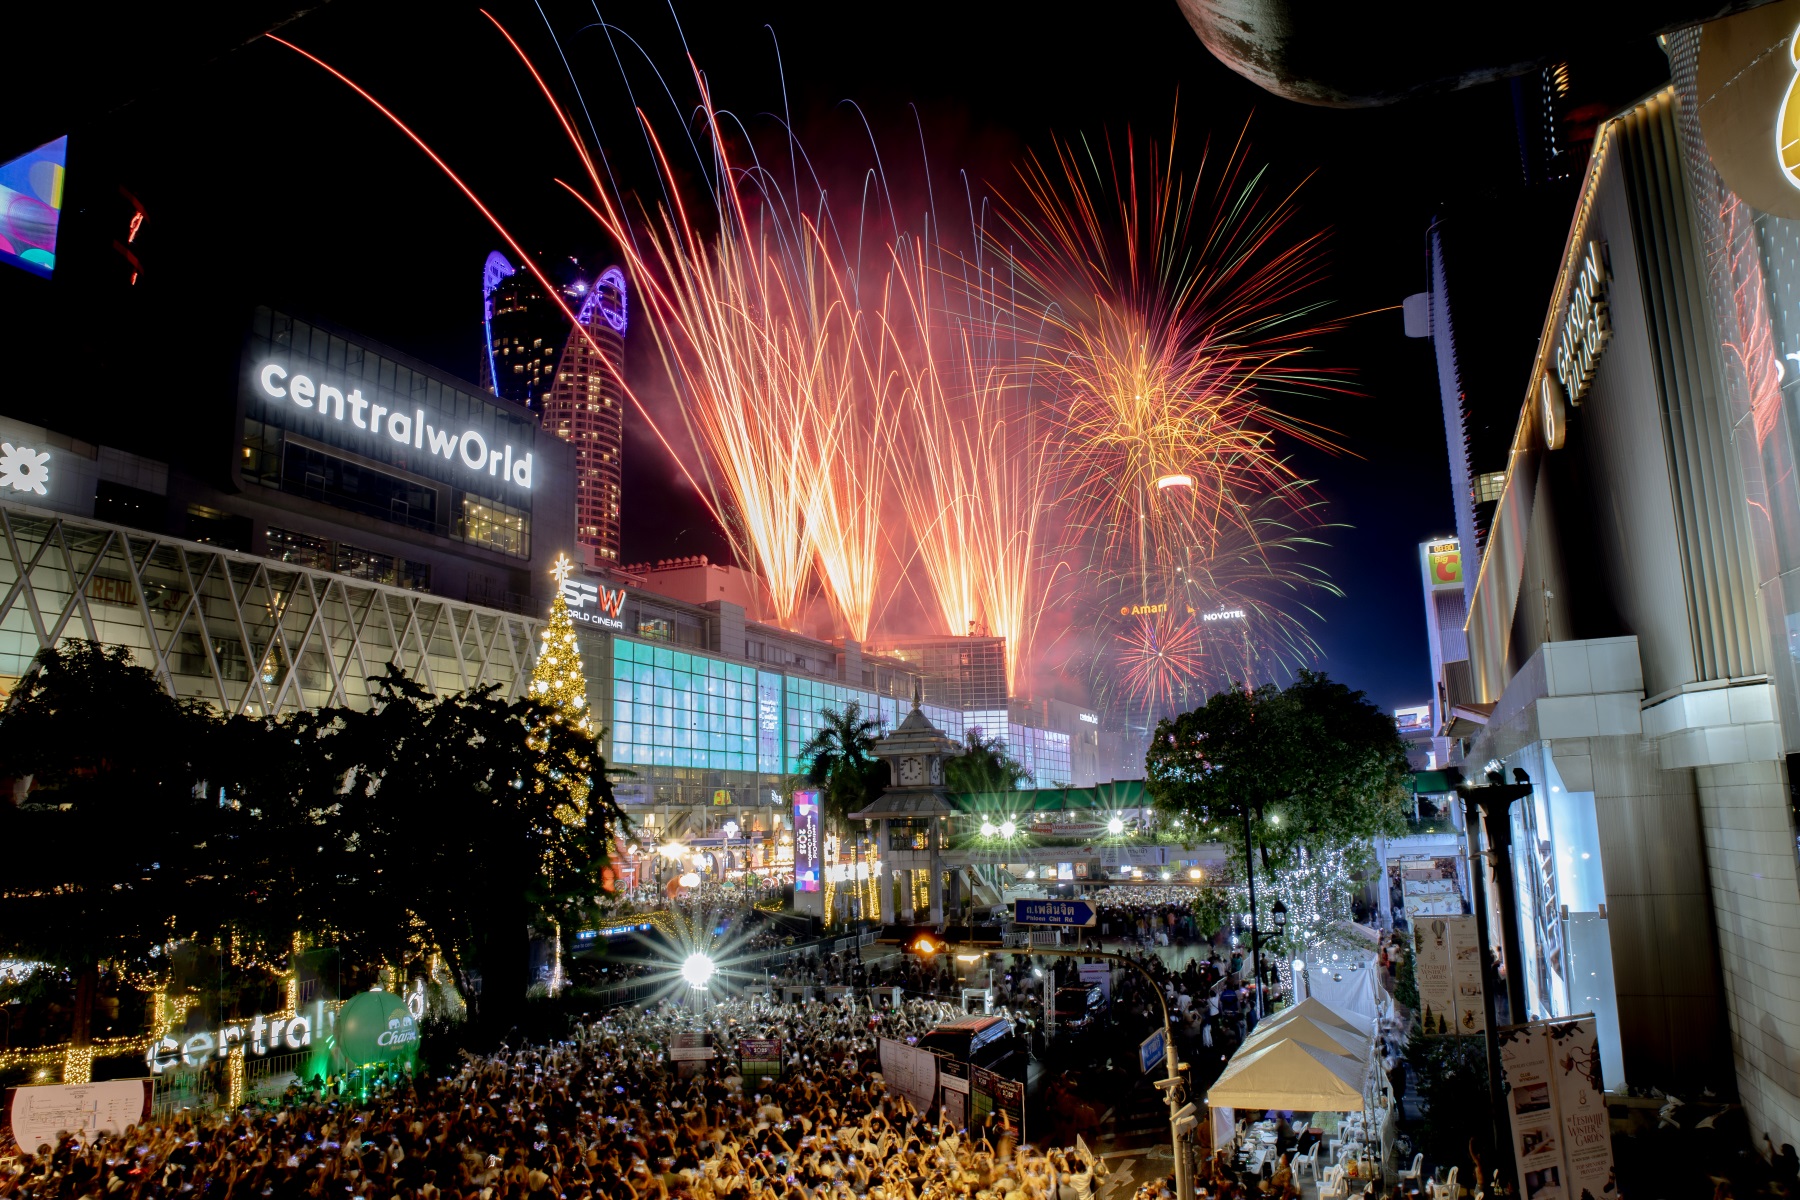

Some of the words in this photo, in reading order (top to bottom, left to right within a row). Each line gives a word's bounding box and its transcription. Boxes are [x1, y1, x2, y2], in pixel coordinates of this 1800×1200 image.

[1557, 240, 1603, 385] GAYSORN
[1434, 555, 1448, 565] Big
[1436, 554, 1458, 581] C
[1131, 603, 1168, 615] Amari
[1203, 610, 1245, 621] NOVOTEL
[568, 609, 590, 621] ORLD
[592, 615, 623, 629] CINEMA
[1026, 902, 1075, 916] ถ.เพลินจิต
